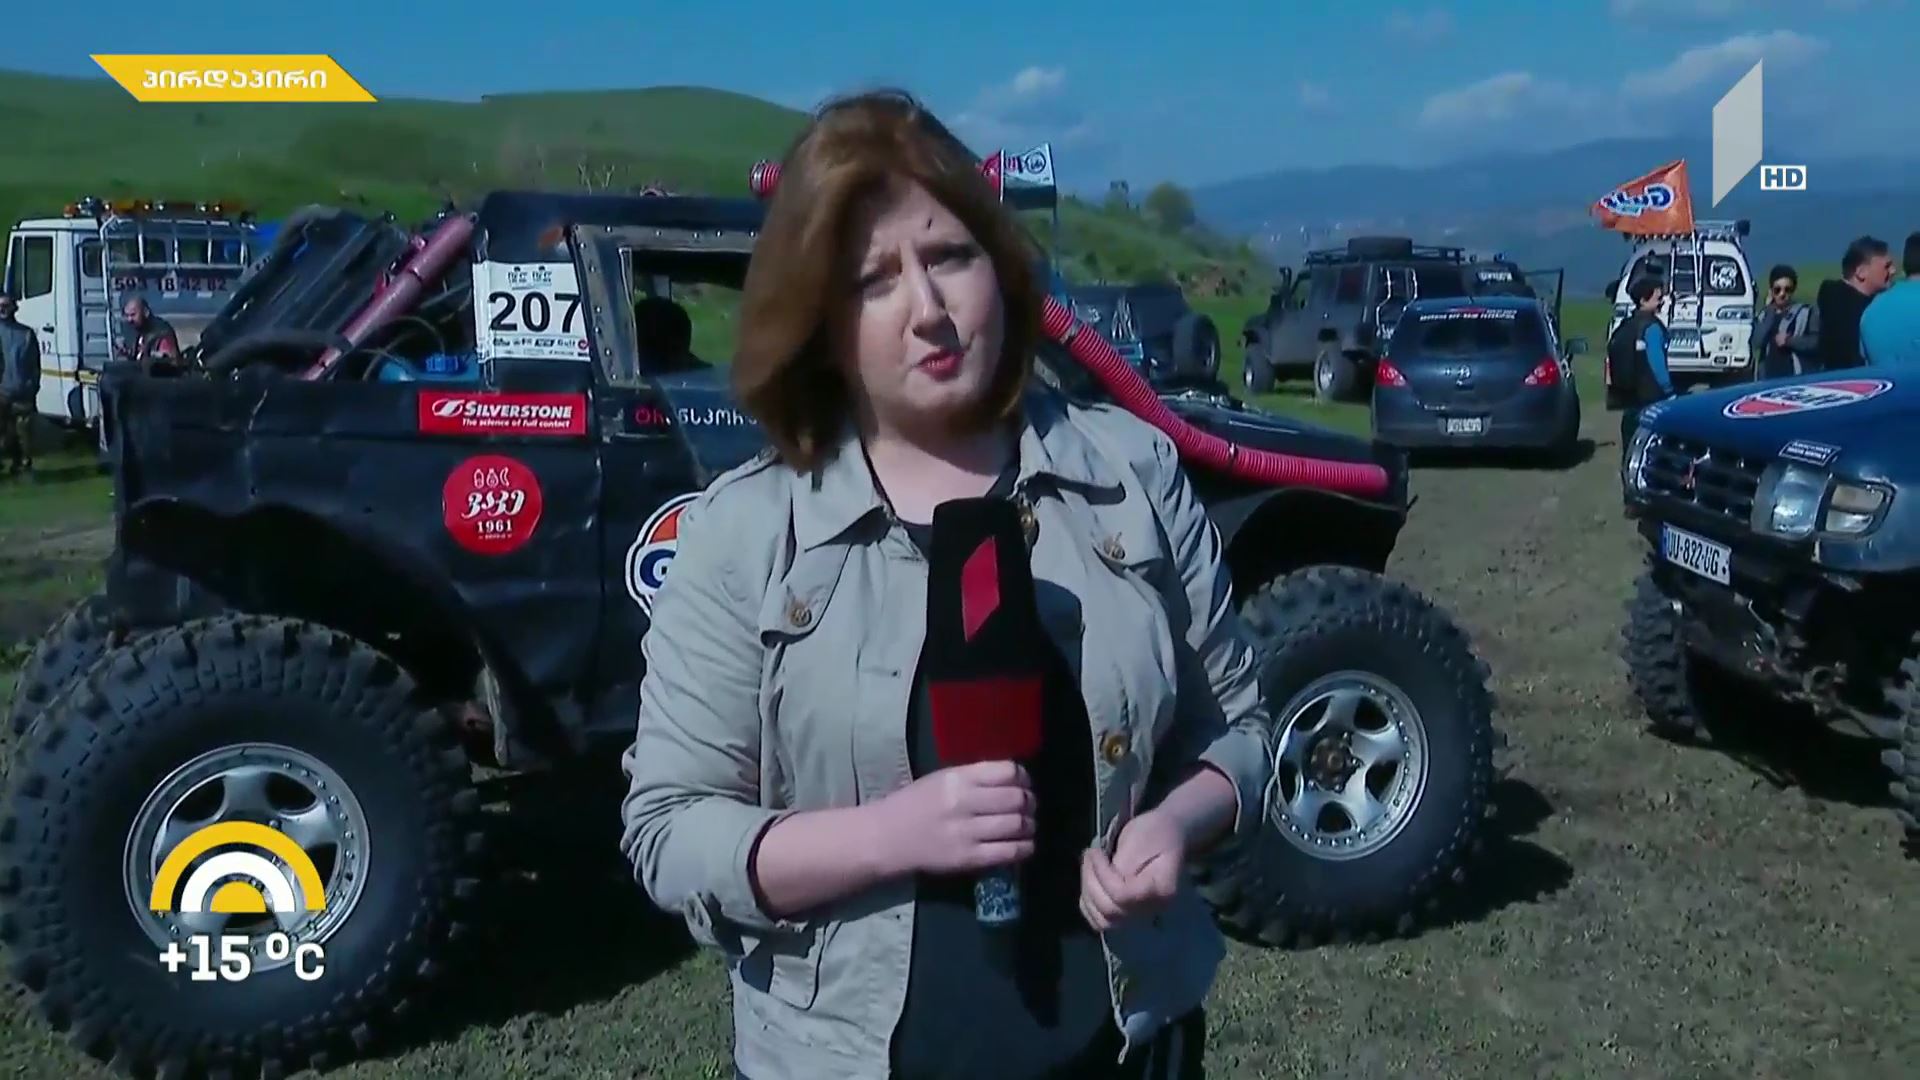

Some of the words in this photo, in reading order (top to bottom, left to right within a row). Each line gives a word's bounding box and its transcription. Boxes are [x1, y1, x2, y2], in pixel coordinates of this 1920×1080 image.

[488, 291, 581, 333] 207
[464, 400, 573, 419] SILVERSTONE
[462, 418, 476, 427] The
[479, 418, 509, 427] science
[511, 419, 521, 427] of
[522, 418, 538, 428] full
[538, 420, 570, 428] contact
[477, 518, 513, 533] 1961
